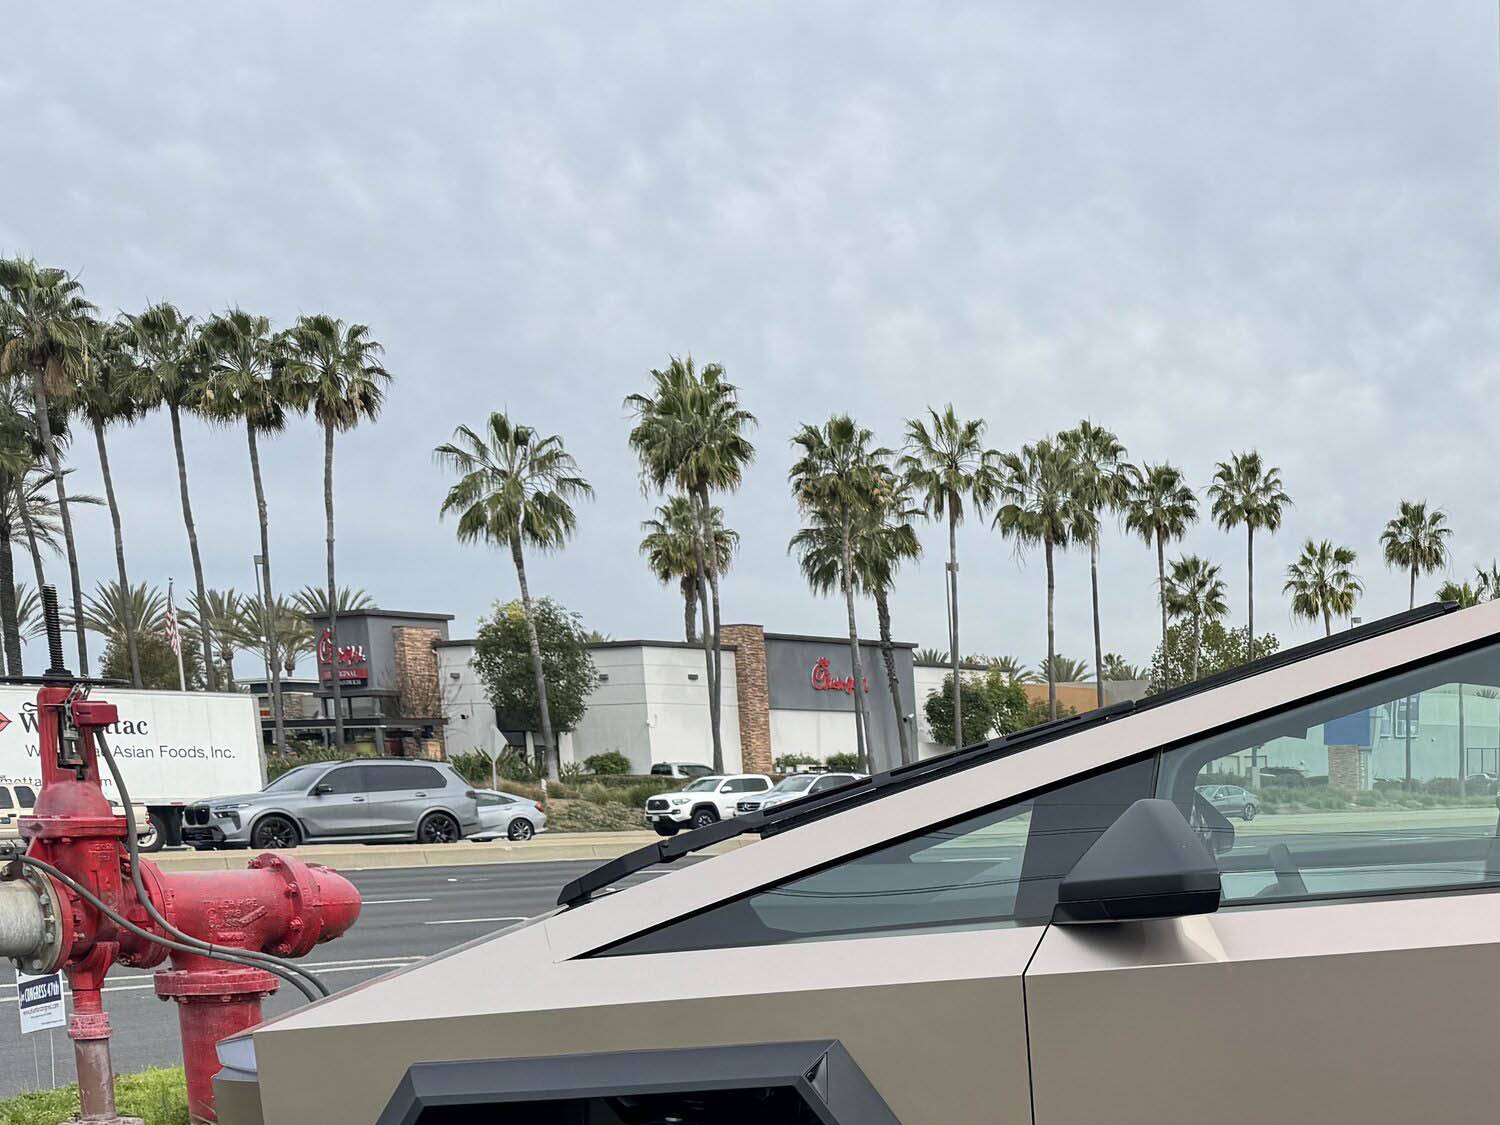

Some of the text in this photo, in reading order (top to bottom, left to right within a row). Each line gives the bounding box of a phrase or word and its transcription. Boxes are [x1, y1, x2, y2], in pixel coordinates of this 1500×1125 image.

[18, 712, 149, 736] Wttac
[113, 745, 154, 759] Asian
[159, 745, 209, 760] Foods,
[211, 746, 236, 760] Inc.
[25, 983, 47, 1002] CONGRESS
